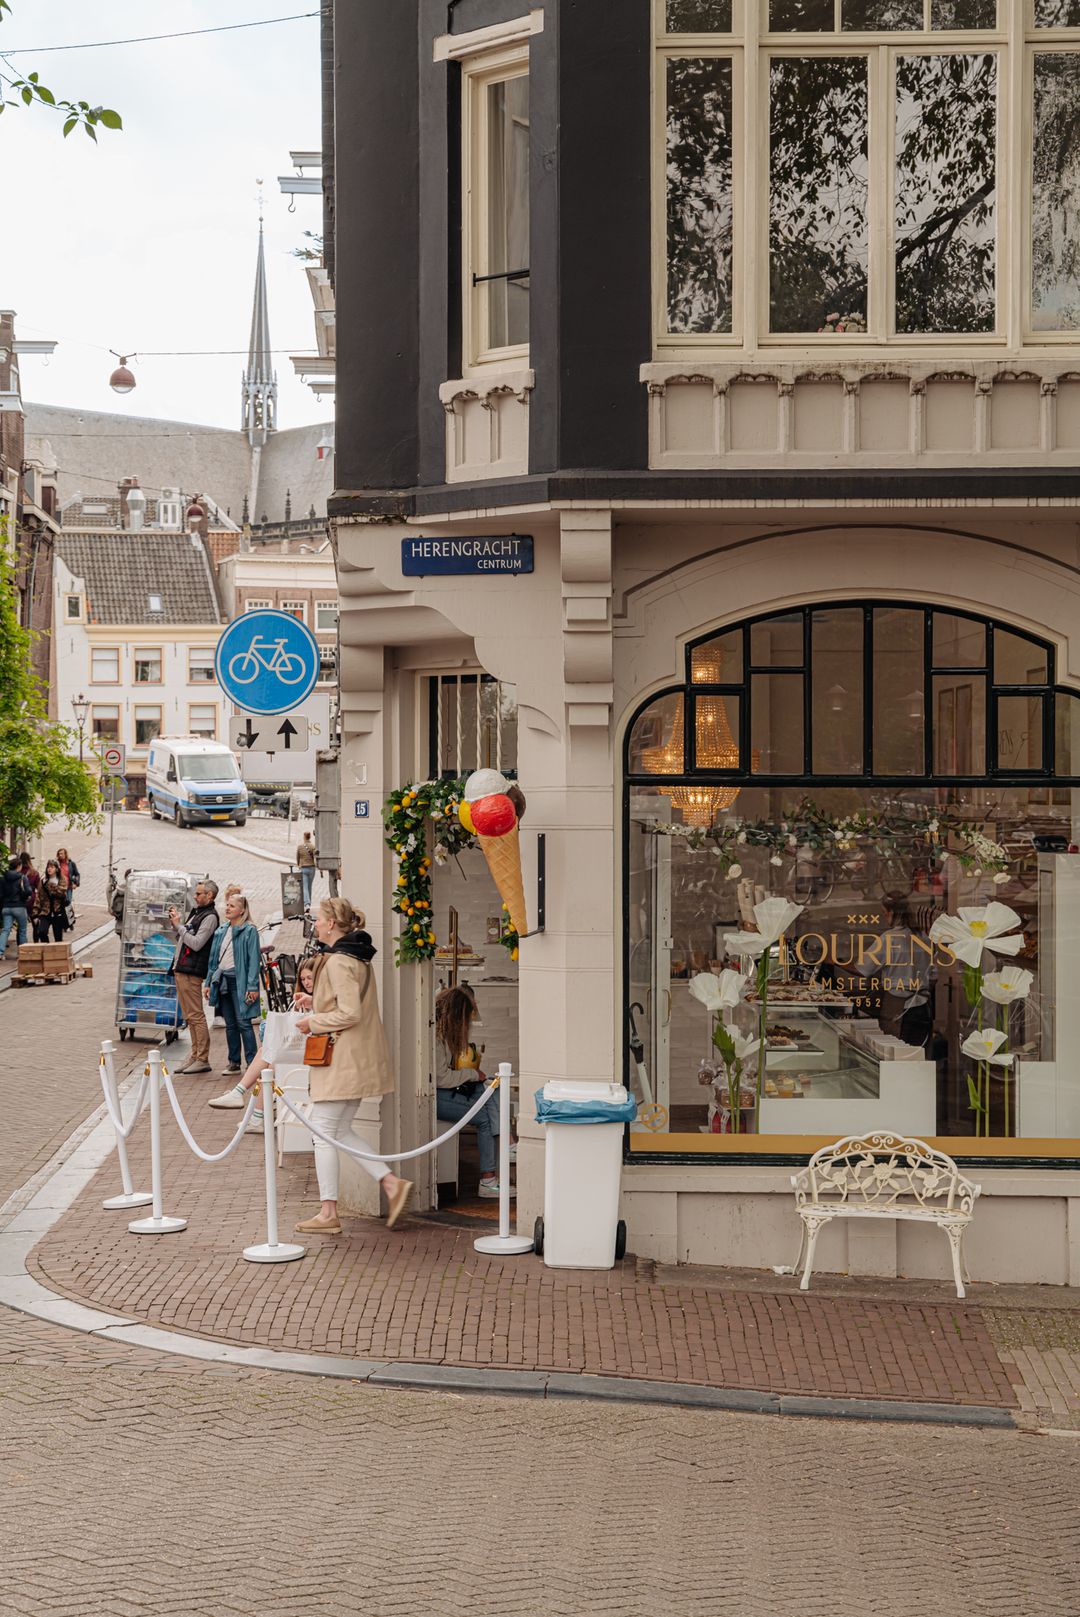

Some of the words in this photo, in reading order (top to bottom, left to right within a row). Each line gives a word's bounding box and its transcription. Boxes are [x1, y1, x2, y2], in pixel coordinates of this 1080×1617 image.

[412, 540, 521, 557] HERENGRACHT
[477, 559, 521, 569] CENTRUM
[356, 803, 366, 815] 15
[778, 933, 957, 967] LOURENS
[808, 977, 921, 991] AMSTERDAM
[847, 997, 881, 1008] 1952
